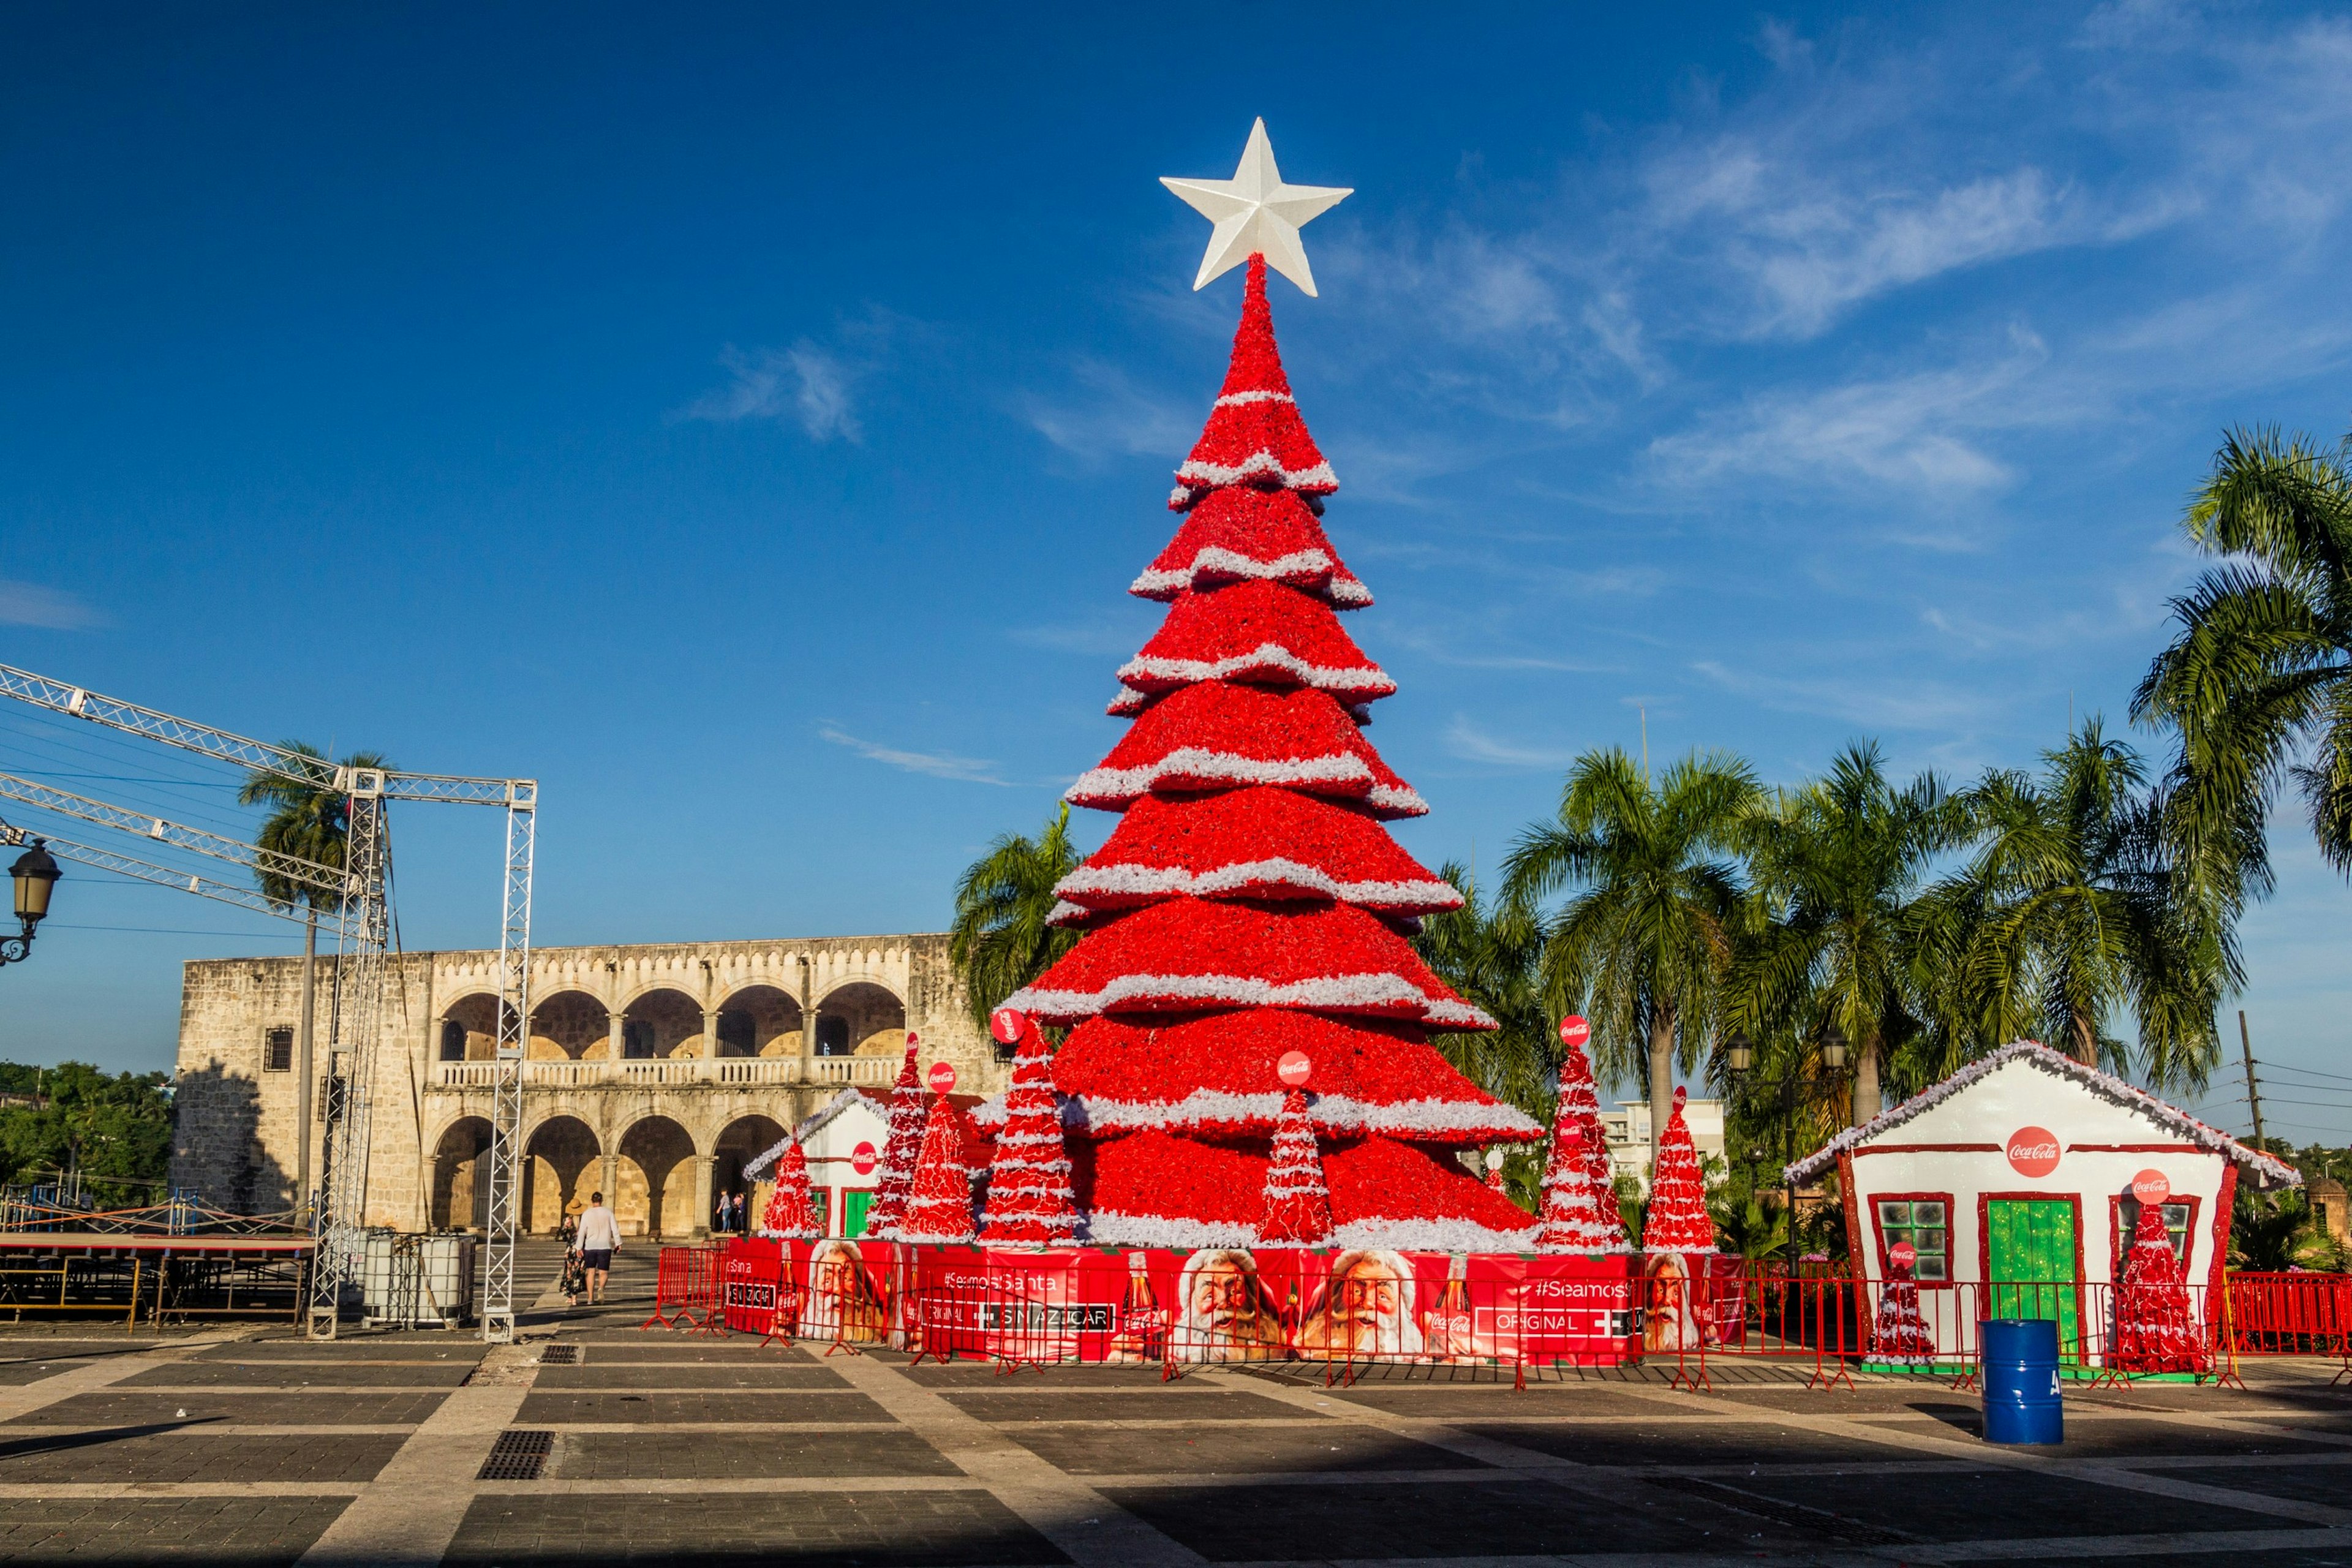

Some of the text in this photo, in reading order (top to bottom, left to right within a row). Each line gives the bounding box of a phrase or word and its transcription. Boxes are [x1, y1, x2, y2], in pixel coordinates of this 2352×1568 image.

[999, 1011, 1017, 1040] Coca-Cola
[1561, 1024, 1588, 1037] Coca-Cola
[1279, 1060, 1309, 1076] Coca-Cola
[930, 1072, 954, 1084] Coca-Cola
[1560, 1126, 1579, 1136] Coca-Cola
[853, 1153, 875, 1163] Coca-Cola
[2010, 1143, 2057, 1160] Coca-Cola
[2133, 1180, 2168, 1193] Coca-Cola
[1890, 1250, 1915, 1260] Coca-Cola
[1431, 1313, 1471, 1333] Coca-Cola
[1497, 1314, 1578, 1330] ORIGINAL
